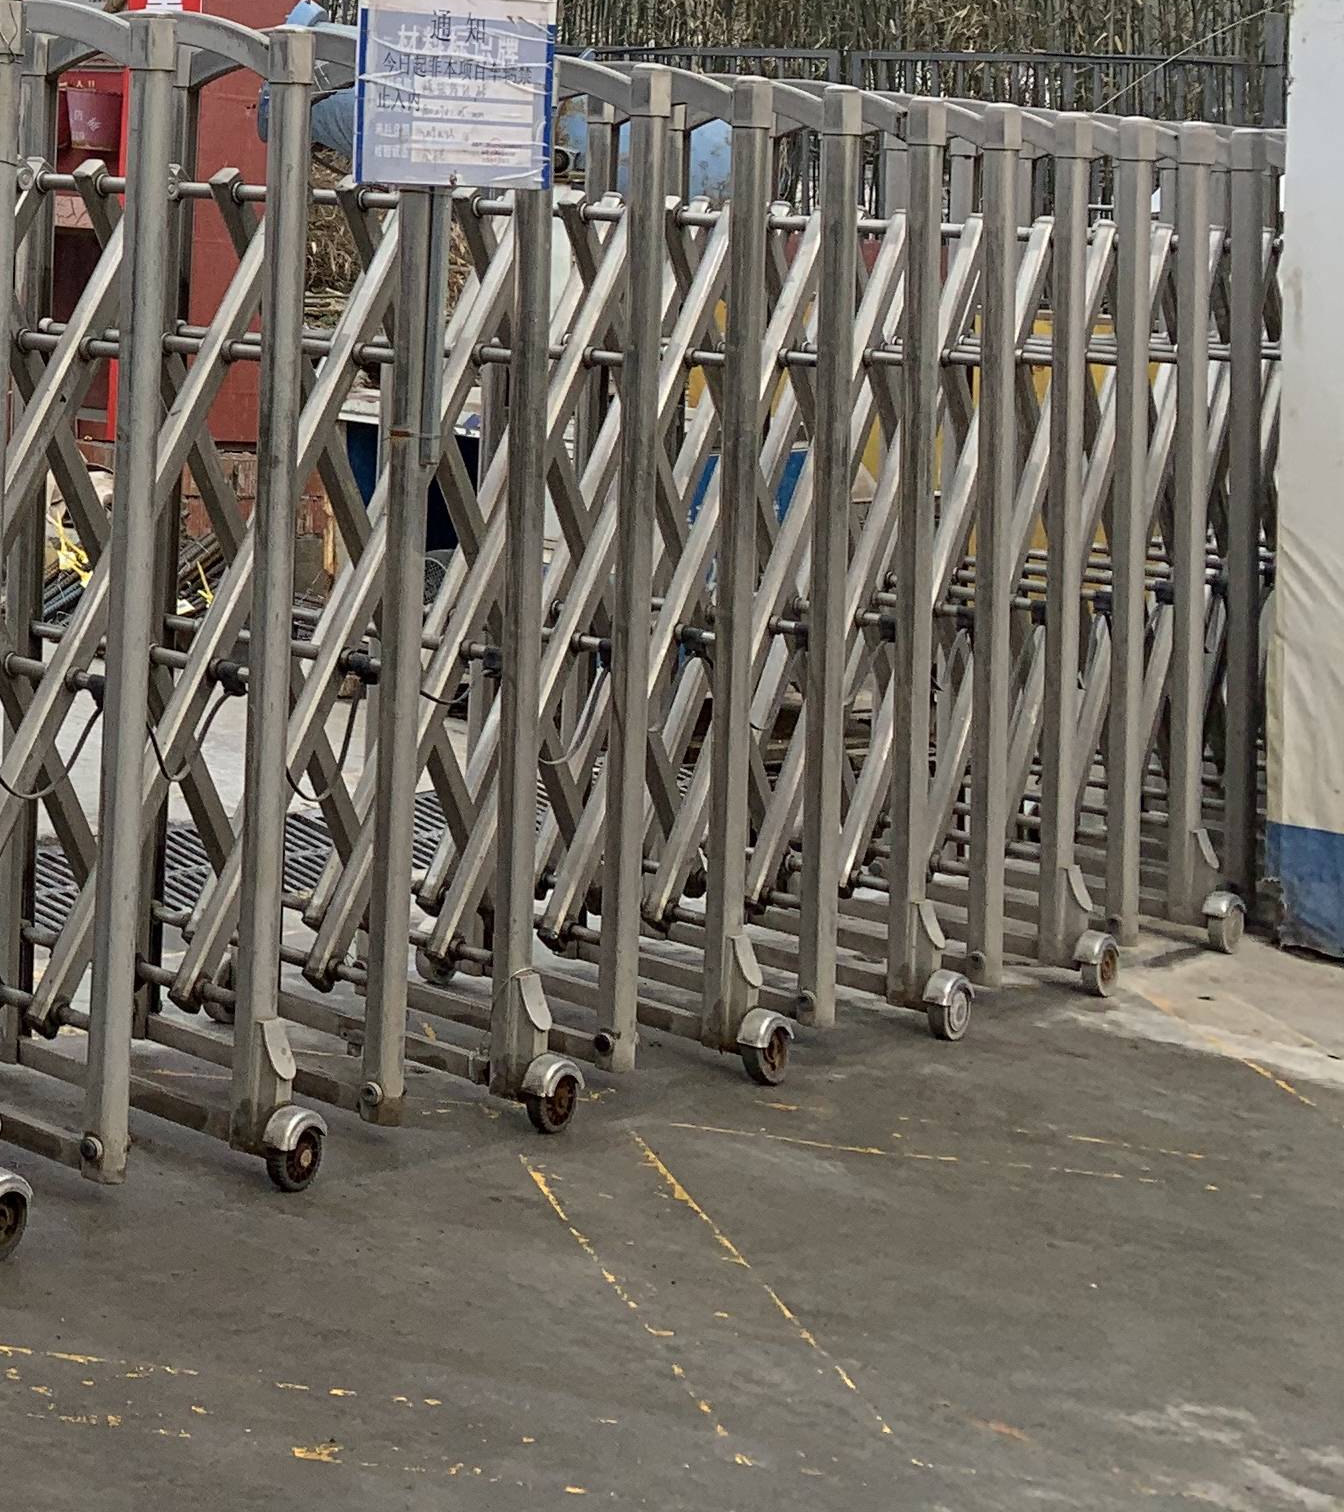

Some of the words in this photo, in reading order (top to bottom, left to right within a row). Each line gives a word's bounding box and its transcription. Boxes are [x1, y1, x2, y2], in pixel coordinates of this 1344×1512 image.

[430, 9, 486, 43] 通知
[376, 86, 421, 112] 止入内
